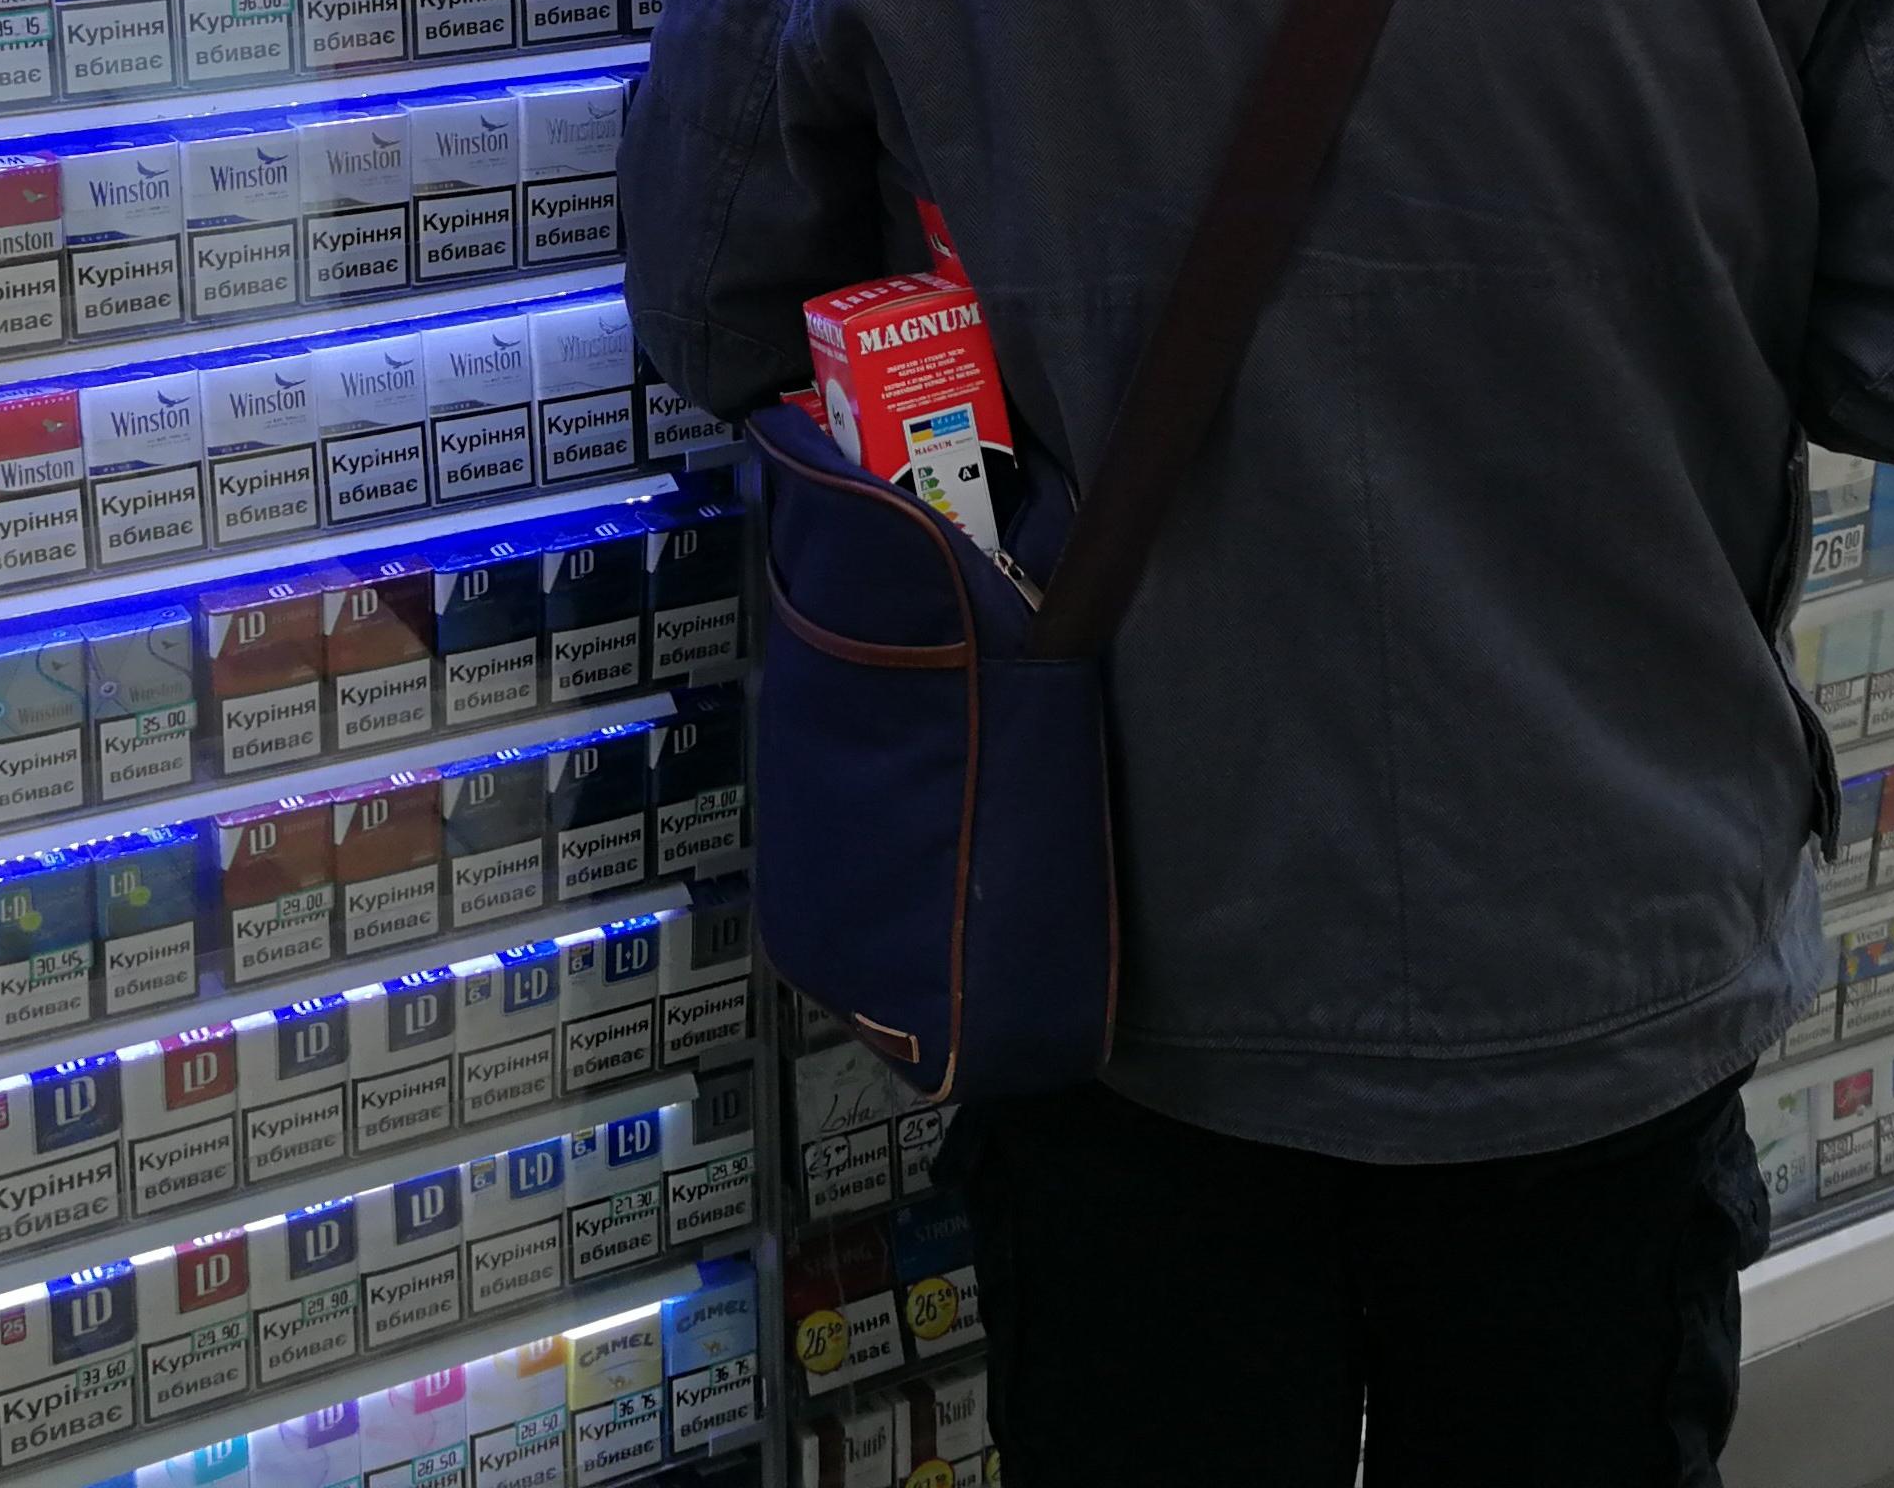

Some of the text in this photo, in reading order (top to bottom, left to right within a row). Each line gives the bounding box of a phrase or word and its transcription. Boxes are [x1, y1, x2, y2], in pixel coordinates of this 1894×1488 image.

[66, 17, 166, 48] Куріння
[312, 26, 396, 53] вбиває
[74, 50, 164, 79] вбиває
[435, 131, 509, 160] Winston
[209, 161, 289, 193] Winston
[421, 207, 510, 235] Куріння
[426, 238, 507, 265] вбиває
[857, 302, 982, 355] MAGNUM
[0, 454, 75, 487] Winston
[330, 442, 421, 475] Куріння
[337, 476, 419, 506] вбиває
[462, 568, 490, 603] LD
[238, 610, 266, 646] LD
[181, 1052, 219, 1091] LD
[578, 1332, 654, 1368] CAMEL
